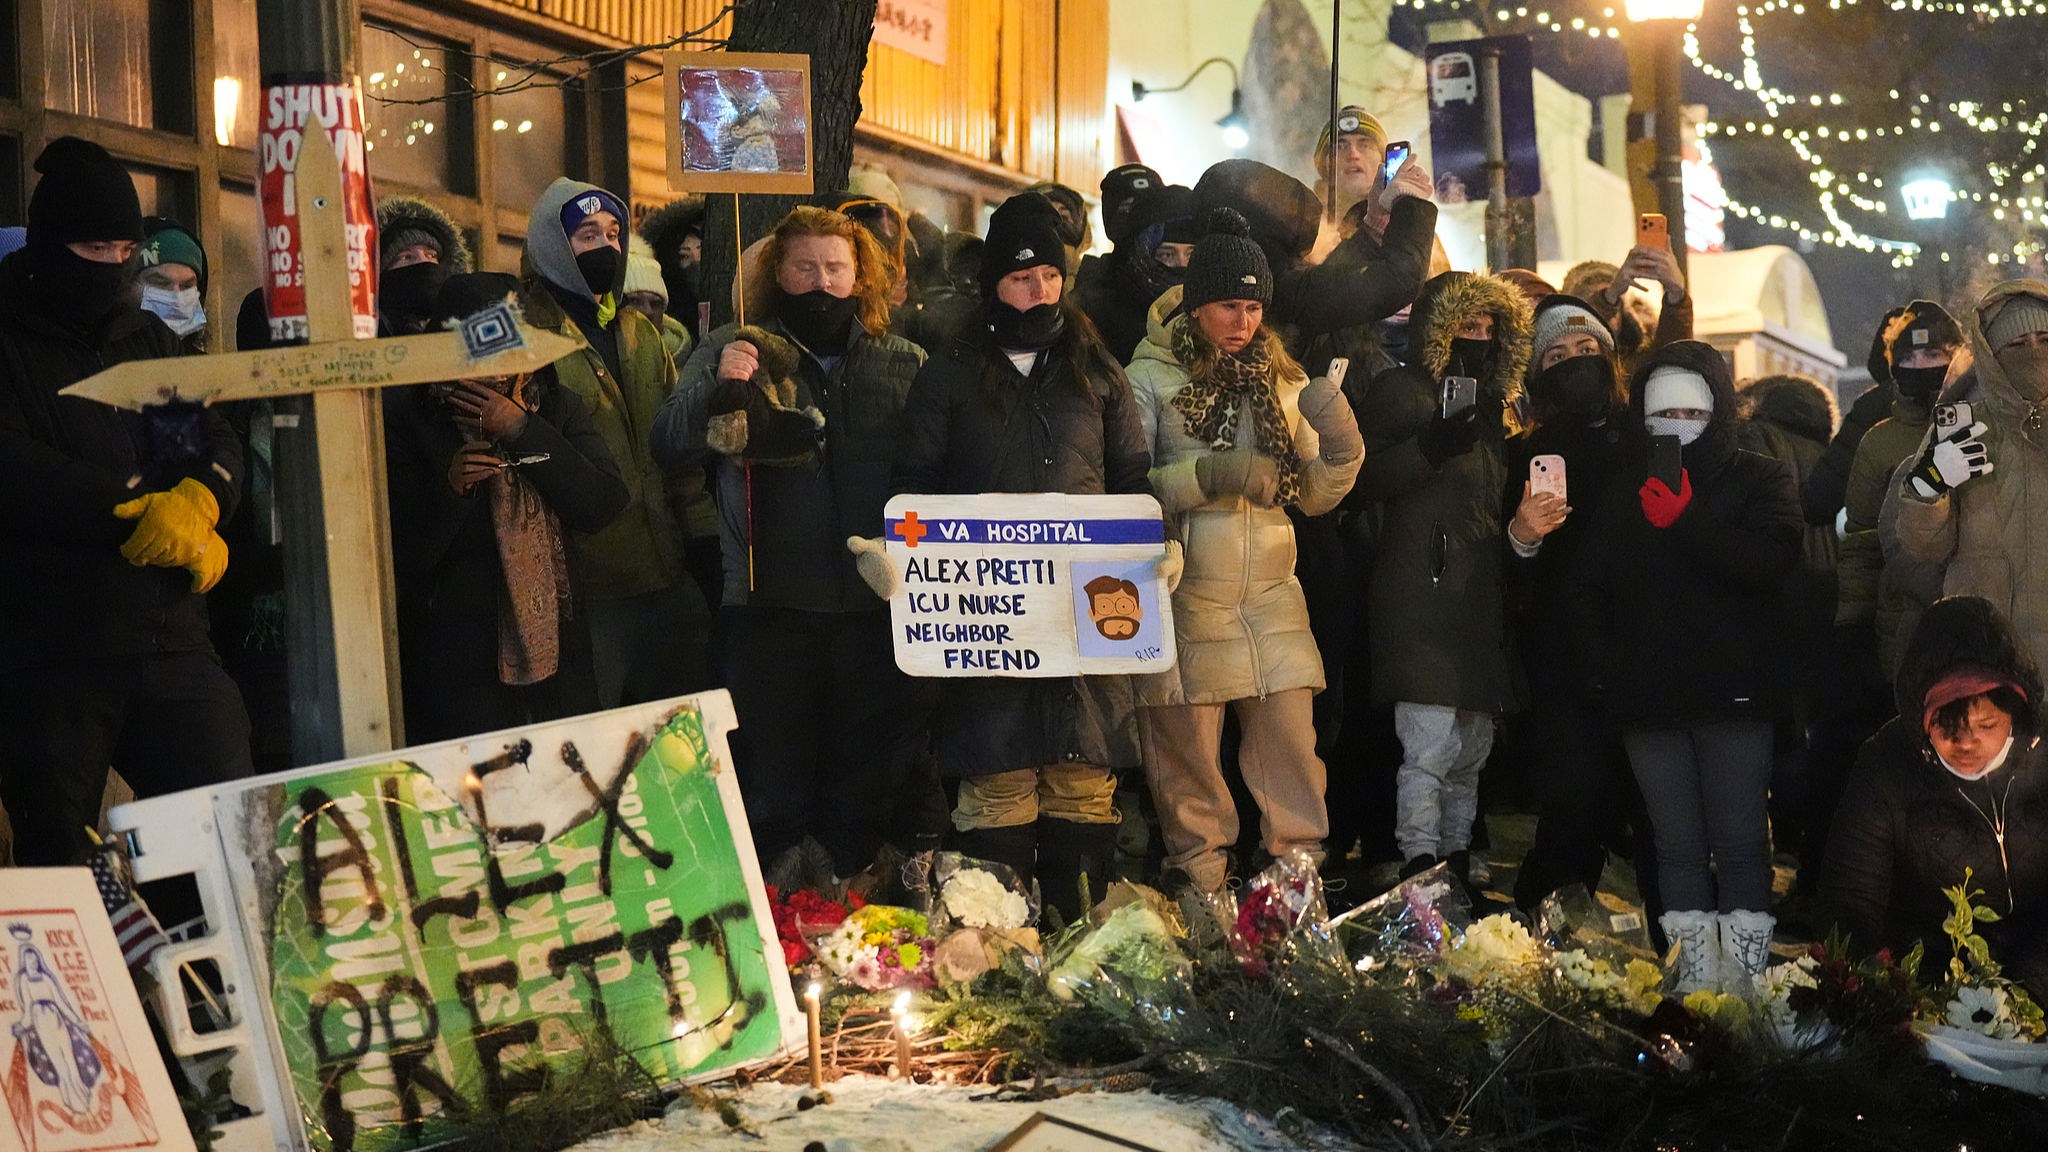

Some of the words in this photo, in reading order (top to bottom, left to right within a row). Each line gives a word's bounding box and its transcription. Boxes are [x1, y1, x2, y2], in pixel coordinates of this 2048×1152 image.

[267, 85, 354, 130] SHUT
[267, 225, 291, 251] NO
[271, 251, 292, 272] NO
[275, 272, 292, 288] NO
[939, 521, 970, 541] VA
[986, 522, 1092, 543] HOSPITAL
[904, 556, 971, 584] ALEX
[976, 558, 1056, 586] PRETTI
[908, 592, 950, 614] ICU
[958, 593, 1026, 616] NURSE
[905, 622, 1014, 645] NEIGHBOR
[944, 648, 1041, 671] FRIEND
[1134, 646, 1157, 661] RIP
[299, 731, 674, 938] ALEX
[44, 929, 78, 948] KICK
[309, 902, 767, 1152] PRETTI
